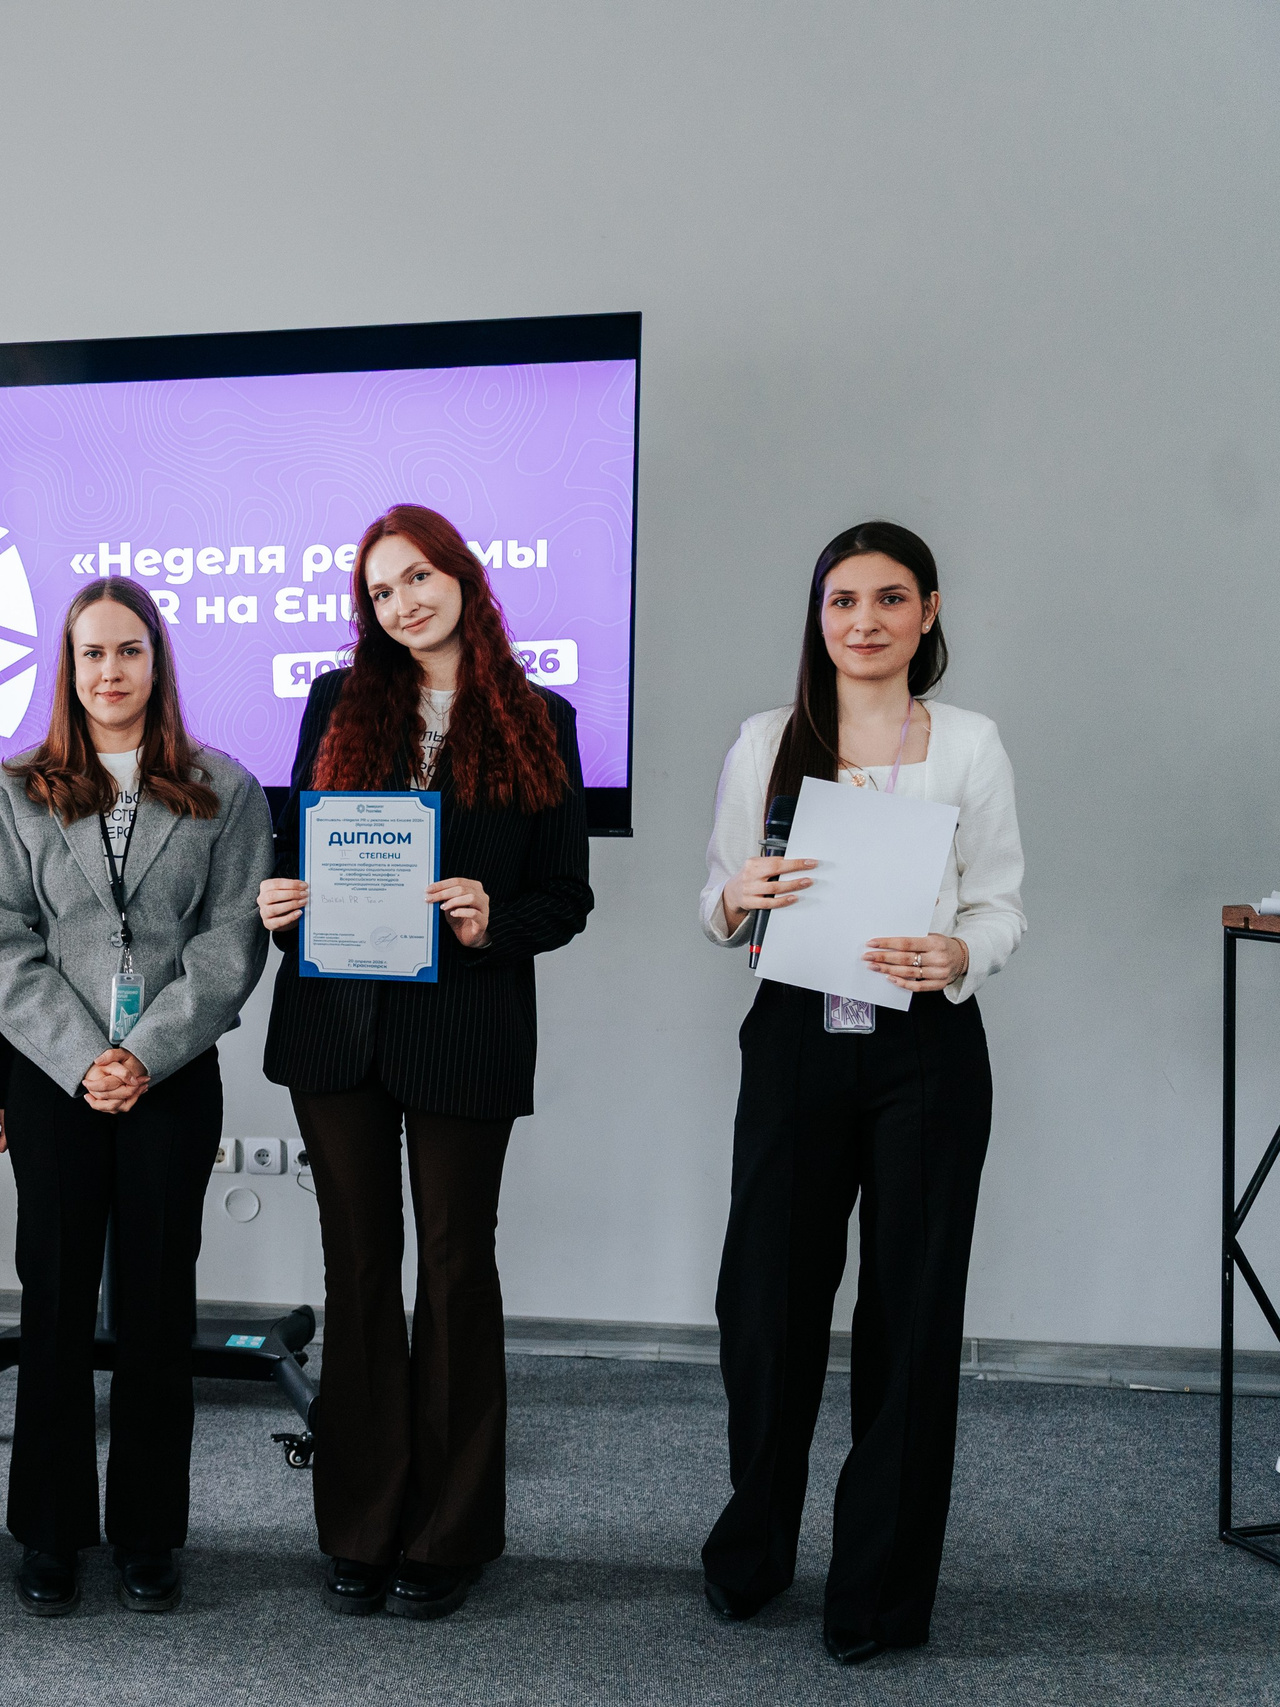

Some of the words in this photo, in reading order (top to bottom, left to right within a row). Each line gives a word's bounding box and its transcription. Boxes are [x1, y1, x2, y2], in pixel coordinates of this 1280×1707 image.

[69, 541, 286, 585] «Неделя
[302, 539, 548, 583] ремы
[196, 595, 258, 625] на
[520, 648, 560, 674] 26
[328, 831, 412, 846] ДИПЛОМ
